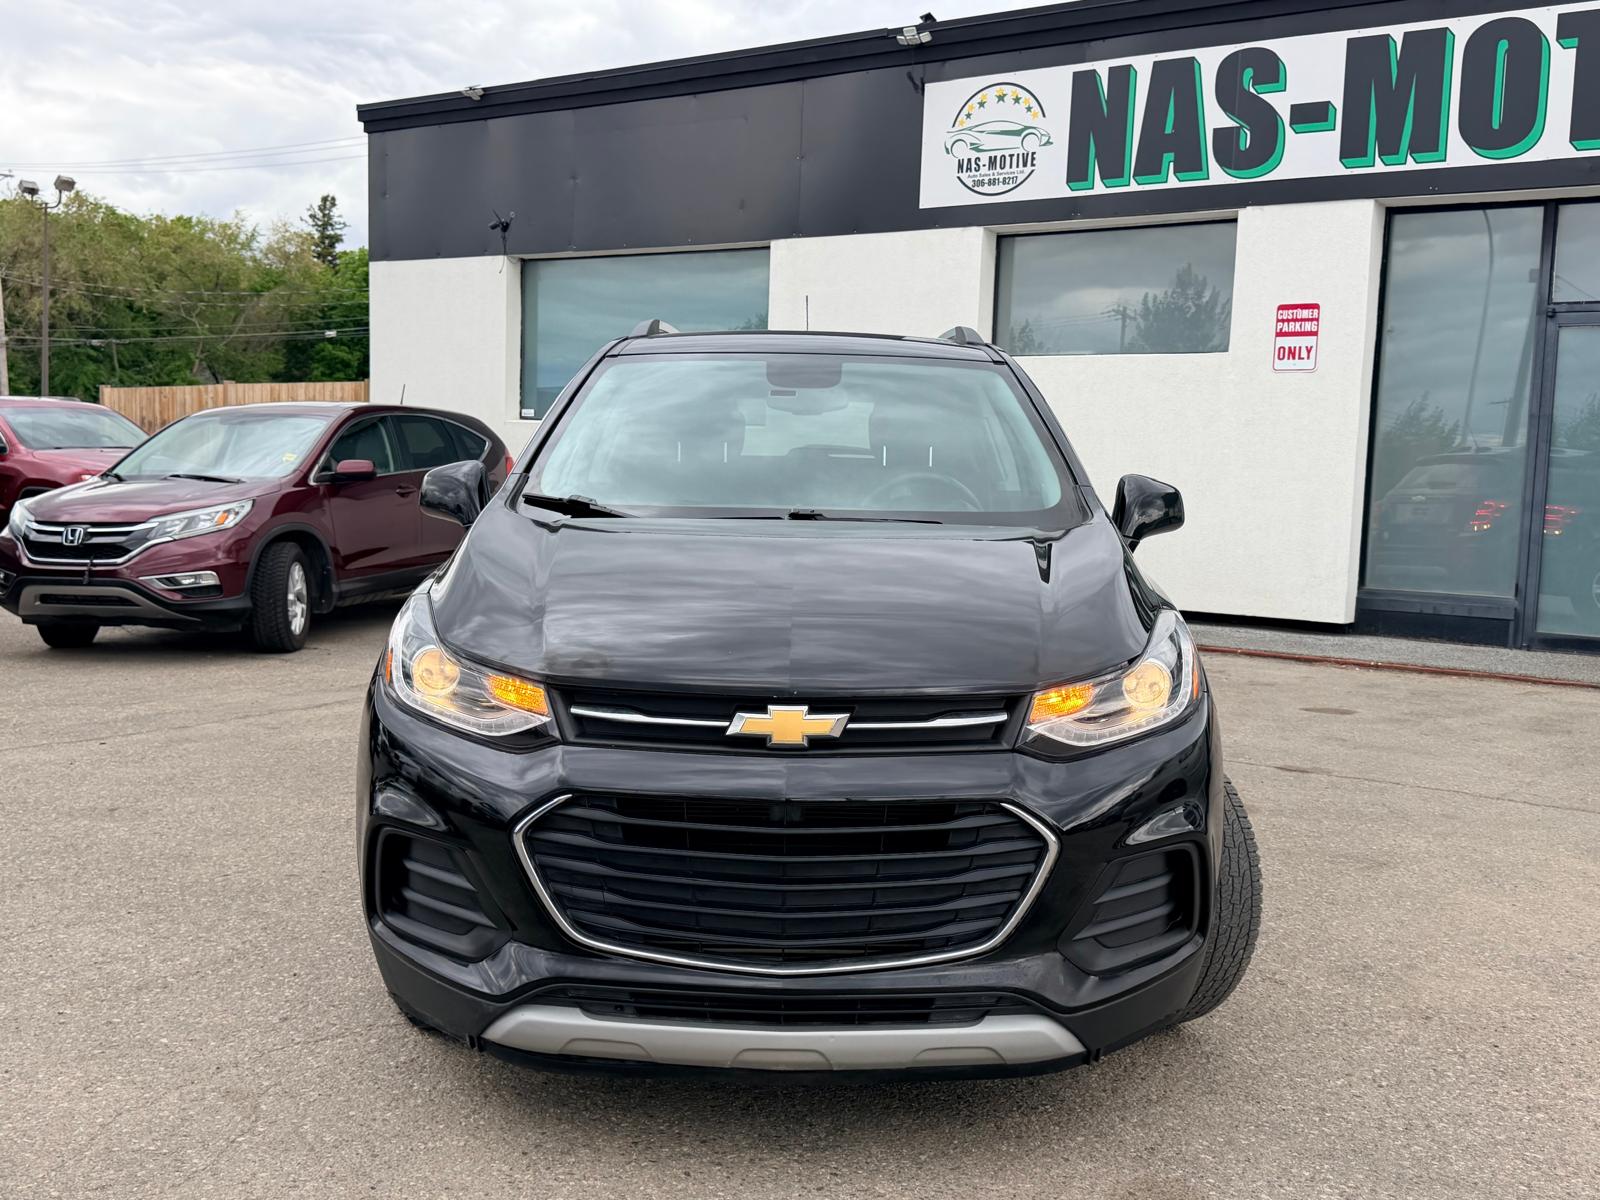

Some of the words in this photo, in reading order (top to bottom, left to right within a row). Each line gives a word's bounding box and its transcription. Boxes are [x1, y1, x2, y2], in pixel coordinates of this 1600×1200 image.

[957, 151, 1036, 174] NAS-MOTIVE
[1277, 308, 1319, 320] CUSTOMER
[1276, 321, 1318, 333] PARKING
[1277, 345, 1313, 361] ONLY
